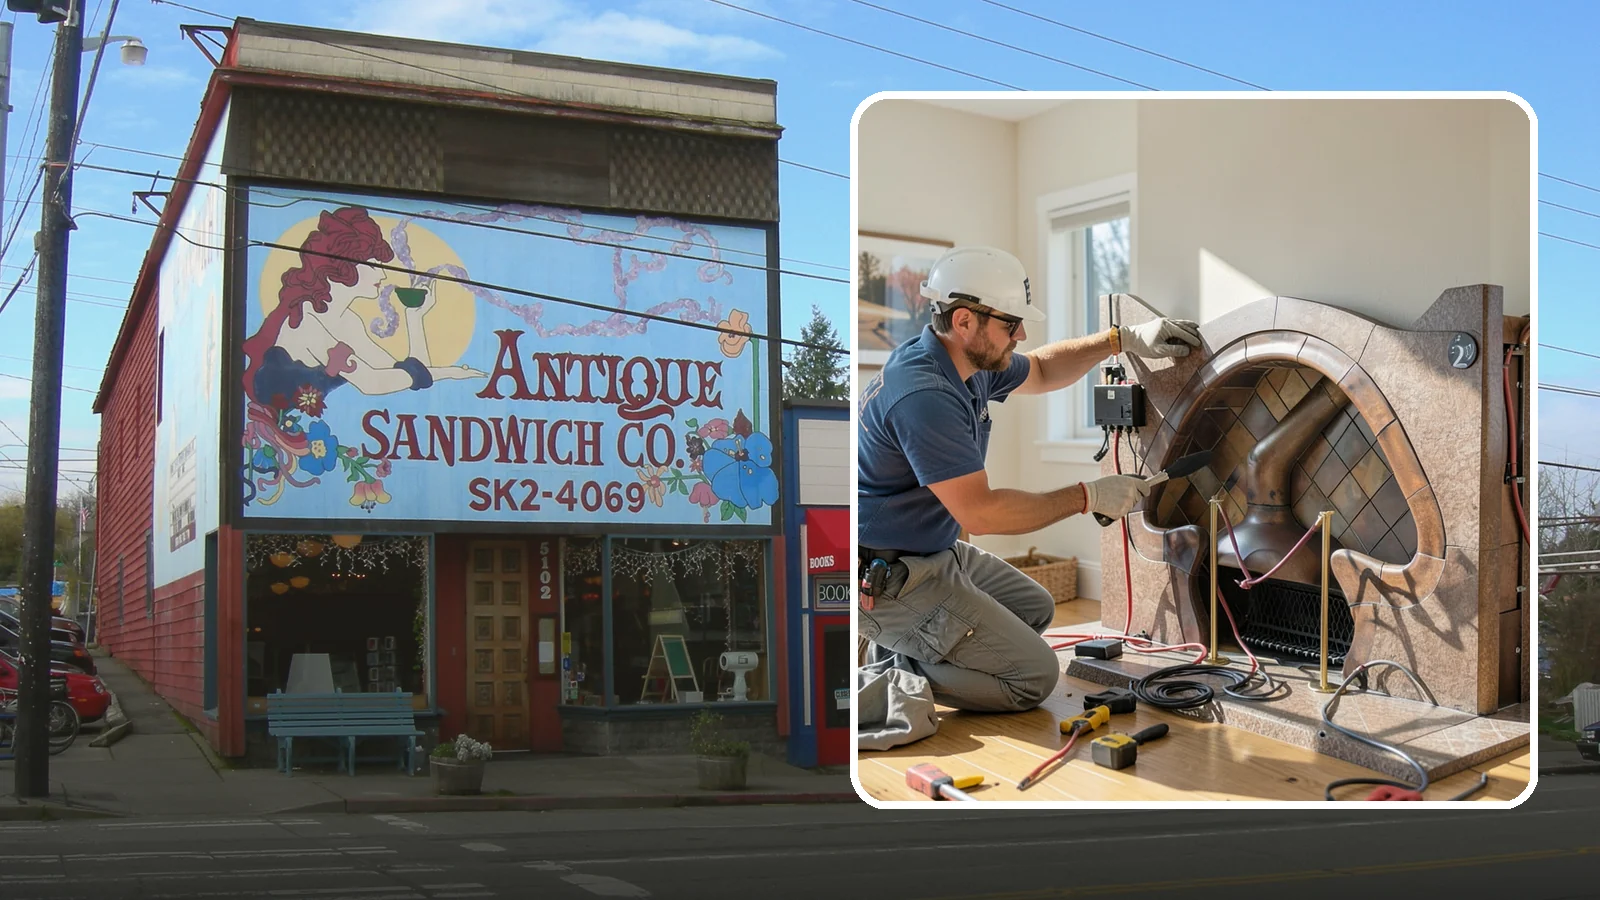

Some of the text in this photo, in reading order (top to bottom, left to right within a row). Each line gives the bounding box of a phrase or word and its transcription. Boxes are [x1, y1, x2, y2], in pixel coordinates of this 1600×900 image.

[476, 329, 722, 420] ANTIQUE
[362, 409, 685, 467] SANDWICH CO.
[469, 477, 646, 513] SK2-4069
[540, 542, 551, 599] 5102
[809, 555, 834, 568] BOOKS
